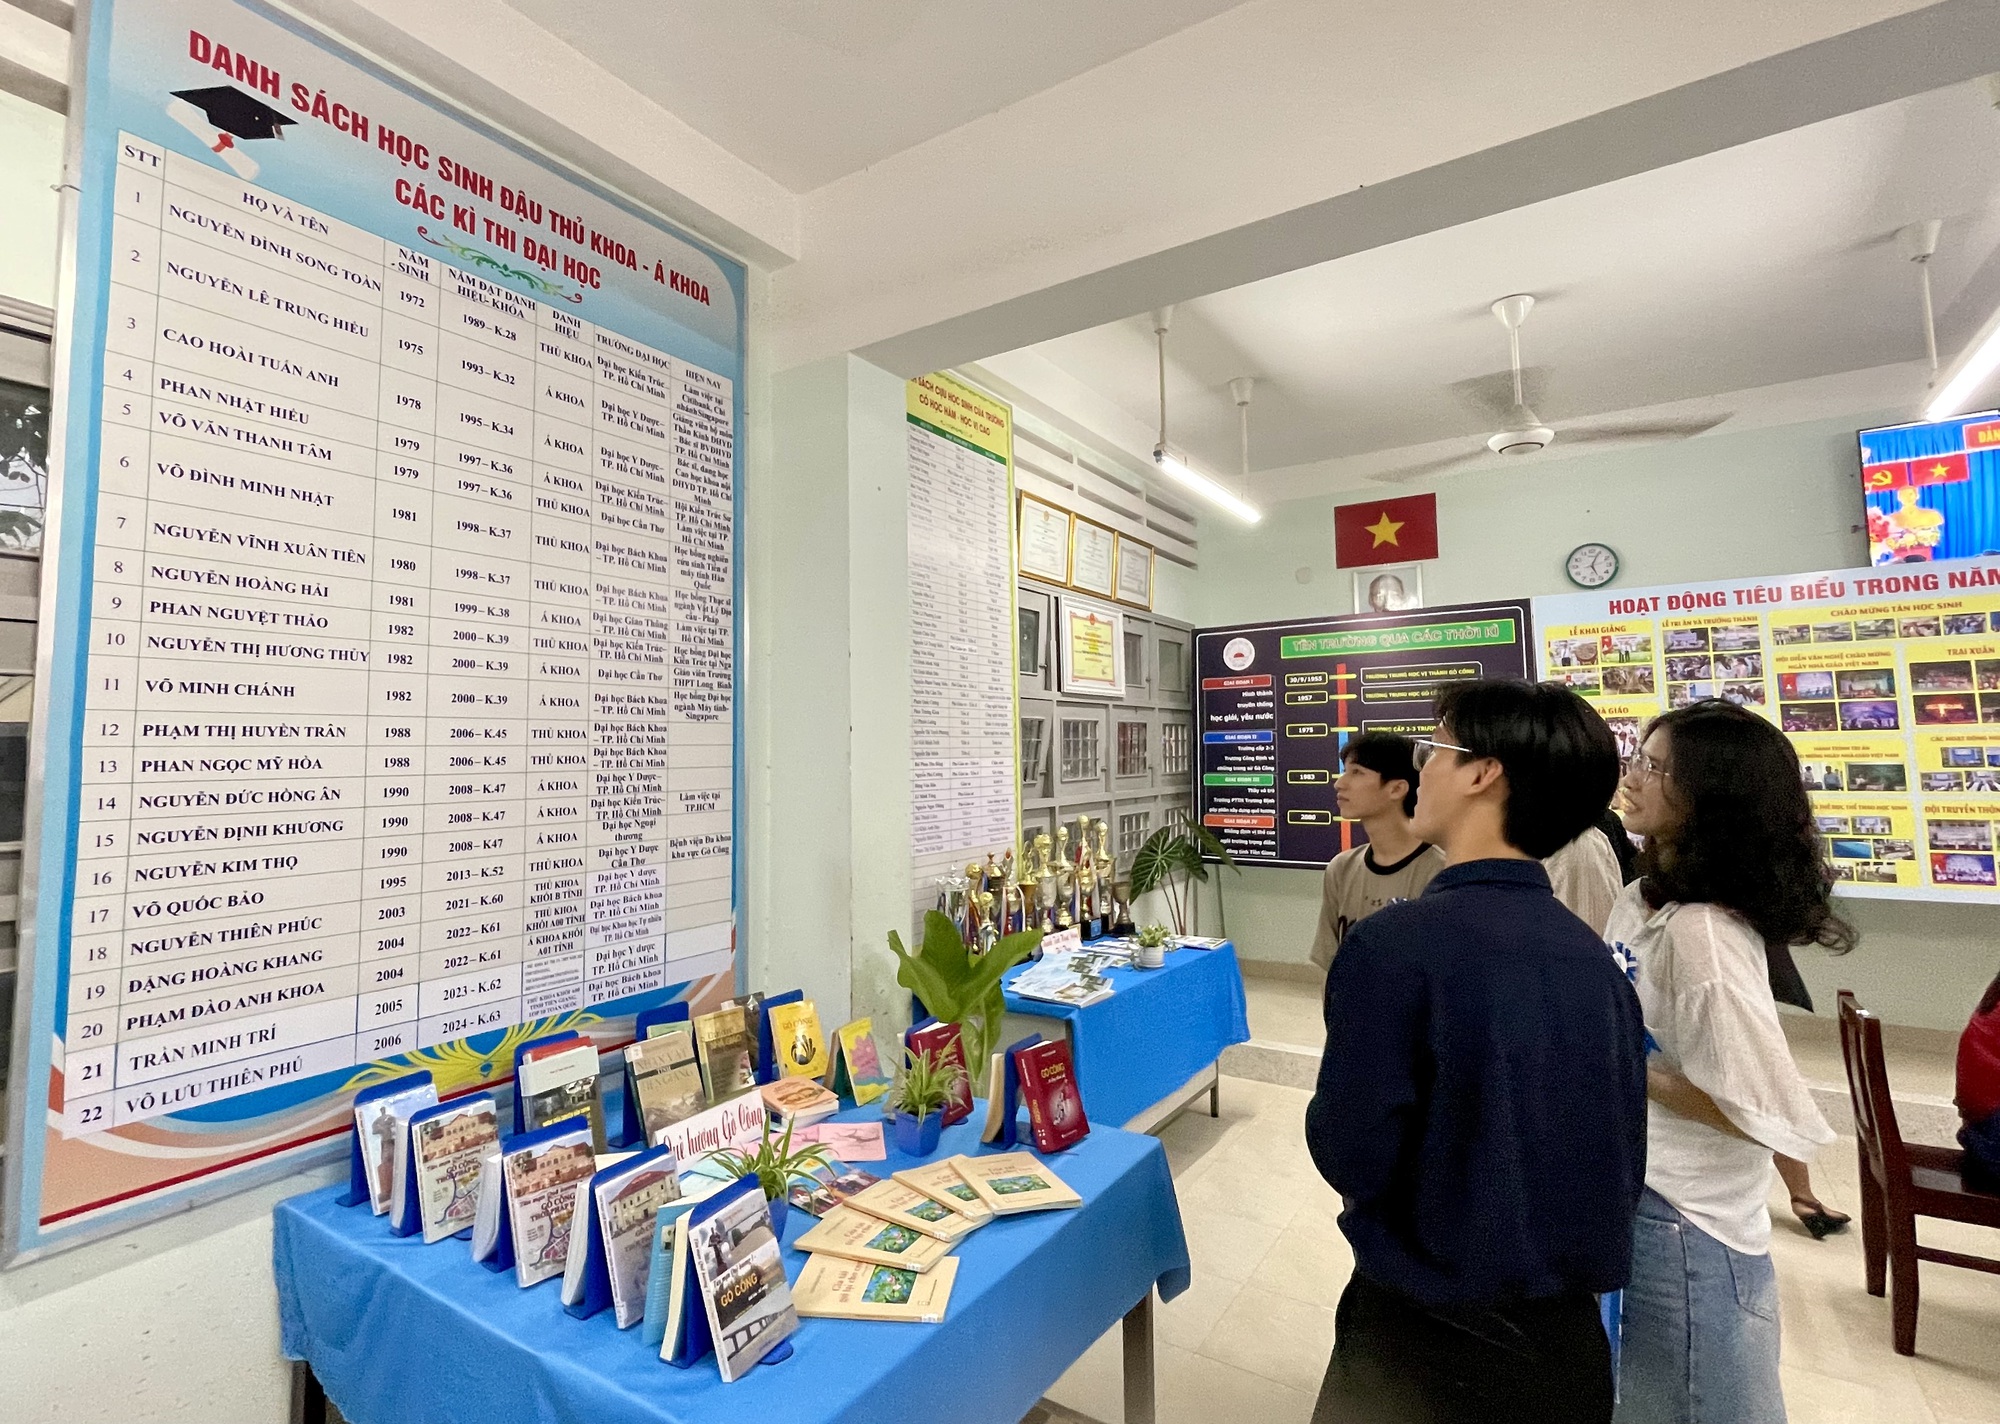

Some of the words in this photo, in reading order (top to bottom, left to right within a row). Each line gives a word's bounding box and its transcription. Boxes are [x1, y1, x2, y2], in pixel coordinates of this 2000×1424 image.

[124, 144, 162, 168] STT
[189, 29, 281, 100] DANH
[291, 82, 369, 143] SÁCH
[378, 124, 429, 170] HỌC
[437, 155, 493, 202] SINH
[499, 186, 542, 226] ĐẬU
[548, 207, 585, 245] THỦ
[590, 229, 638, 271] KHOA
[654, 259, 665, 285] Á
[669, 269, 710, 306] KHOA
[242, 191, 268, 212] HỌ
[271, 201, 294, 222] VÀ
[297, 208, 330, 236] TÊN
[394, 177, 445, 221] CÁC
[453, 203, 476, 235] KÌ
[483, 216, 517, 252] THI
[523, 236, 557, 272] ĐẠI
[563, 254, 601, 290] HỌC
[169, 203, 246, 242] NGUYỄN
[250, 229, 292, 260] ĐÌNH
[295, 250, 338, 278] SONG
[341, 263, 382, 293] TOÀN
[396, 394, 422, 410] 1978
[918, 376, 934, 391] SÁCH
[961, 399, 973, 411] SINH
[919, 394, 929, 406] CÓ
[930, 399, 943, 413] HỌC
[944, 406, 956, 420] HÀM
[960, 414, 972, 428] HỌC
[979, 424, 990, 436] CAO
[158, 410, 187, 428] VÕ
[191, 417, 230, 438] VĂN
[233, 427, 293, 453] THANH
[297, 442, 332, 461] TÂM
[1609, 596, 1660, 616] HOẠT
[1667, 590, 1727, 612] ĐỘNG
[1733, 584, 1782, 605] TIÊU
[1790, 576, 1846, 600] BIỂU
[1853, 573, 1939, 596] TRONG
[150, 600, 202, 618] PHAN
[207, 605, 280, 626] NGUYỆT
[283, 612, 328, 629] THẢO
[1831, 608, 1857, 617] CHÀO
[1892, 604, 1911, 613] TÂN
[1913, 603, 1935, 612] HỌC
[1937, 601, 1962, 610] SINH
[1293, 639, 1317, 651] TÊN
[1319, 634, 1377, 650] TRƯỜNG
[1379, 633, 1409, 647] QUA
[1412, 629, 1442, 642] CÁC
[1445, 625, 1482, 641] THỜI
[1485, 623, 1499, 638] KÌ
[1580, 626, 1600, 635] KHAI
[1600, 624, 1627, 634] GIẢNG
[1969, 647, 1995, 655] XUÂN
[104, 678, 120, 691] 11
[145, 678, 174, 693] VÕ
[178, 681, 229, 695] MINH
[234, 680, 295, 697] CHÁNH
[1210, 714, 1223, 723] học
[1608, 706, 1629, 715] GIÁO
[385, 728, 411, 738] 1988
[531, 727, 553, 739] THỦ
[556, 729, 587, 739] KHOA
[609, 722, 624, 734] học
[626, 722, 646, 733] Bách
[647, 723, 667, 733] Khoa
[1298, 726, 1314, 734] 1975
[601, 735, 614, 744] TP.
[630, 734, 644, 744] Chí
[645, 735, 666, 744] Minh
[99, 760, 117, 773] 13
[141, 759, 194, 772] PHAN
[200, 758, 252, 774] NGỌC
[257, 756, 283, 771] MỸ
[288, 754, 323, 770] HÒA
[1925, 804, 1940, 814] ĐỘI
[96, 835, 114, 848] 15
[137, 825, 218, 845] NGUYỄN
[224, 825, 267, 841] ĐỊNH
[272, 820, 344, 836] KHƯƠNG
[378, 906, 406, 920] 2003
[130, 931, 213, 956] NGUYỄN
[218, 924, 273, 944] THIÊN
[278, 917, 323, 934] PHÚC
[88, 947, 106, 962] 18
[443, 986, 468, 1000] 2023
[478, 978, 502, 993] K.62
[127, 1008, 185, 1031] PHẠM
[191, 998, 231, 1018] ĐÀO
[235, 992, 273, 1010] ANH
[278, 982, 325, 1002] KHOA
[82, 1024, 103, 1040] 20
[373, 1033, 402, 1051] 2006
[127, 1092, 155, 1114] VÕ
[162, 1083, 202, 1106] LƯU
[207, 1066, 263, 1095] THIÊN
[269, 1055, 304, 1079] PHÚ
[81, 1107, 102, 1124] 22
[738, 1102, 763, 1132] Công
